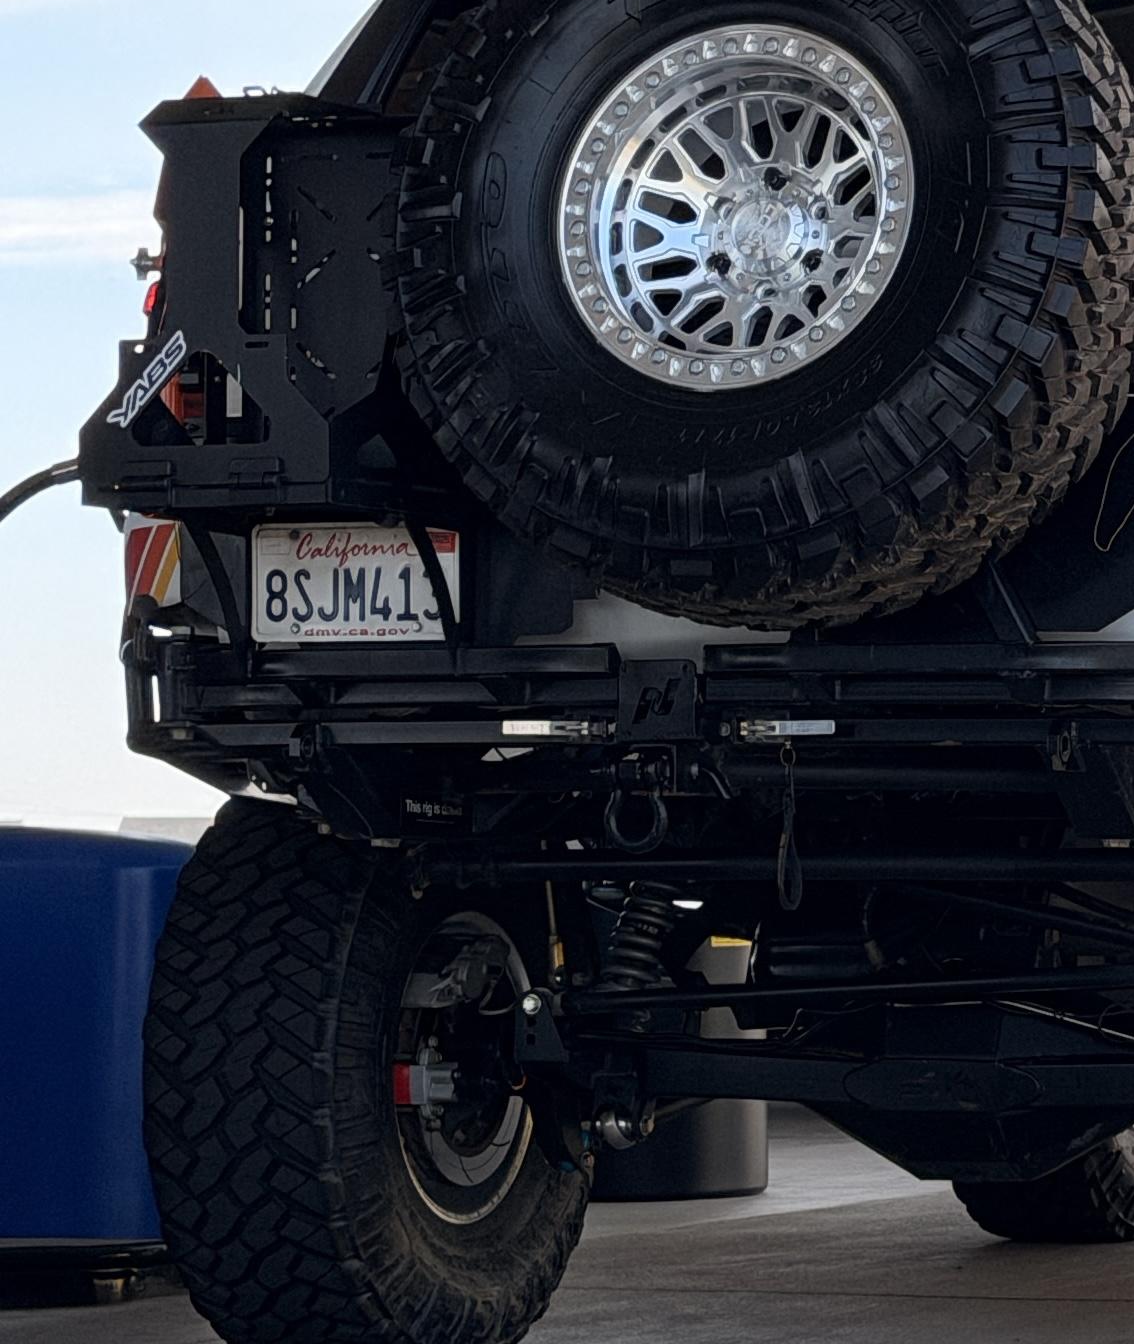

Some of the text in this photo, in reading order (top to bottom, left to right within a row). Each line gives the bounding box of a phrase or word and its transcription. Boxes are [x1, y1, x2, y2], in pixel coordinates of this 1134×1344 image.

[106, 329, 187, 429] YABS
[296, 529, 418, 568] California
[303, 625, 410, 637] dmv.ca.gov
[405, 799, 421, 814] This
